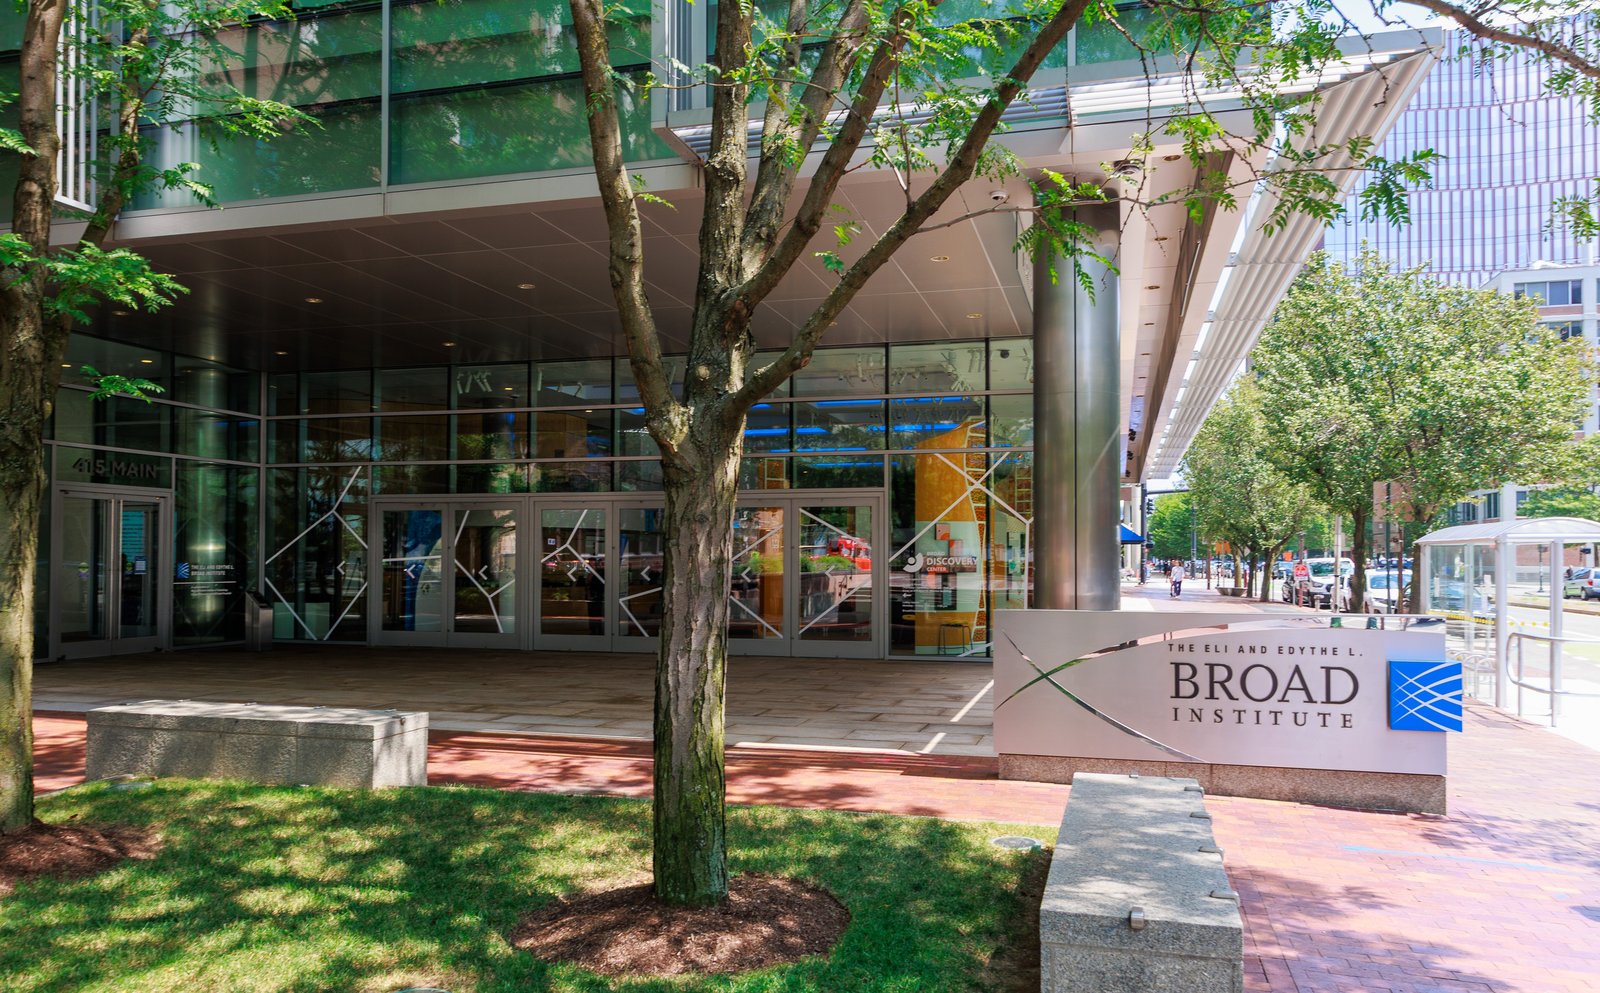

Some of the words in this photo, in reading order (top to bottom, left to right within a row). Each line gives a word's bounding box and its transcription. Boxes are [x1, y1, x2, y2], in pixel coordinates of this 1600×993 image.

[72, 457, 105, 475] 415
[111, 459, 157, 480] MAIN
[926, 556, 978, 566] DISCOVERY
[1168, 643, 1195, 653] THE
[1204, 644, 1228, 654] ELI
[1238, 645, 1267, 655] AND
[1277, 646, 1339, 657] EDYTHE
[1348, 647, 1363, 658] L.
[1169, 661, 1359, 705] BROAD
[1171, 707, 1354, 729] INSTITUTE
